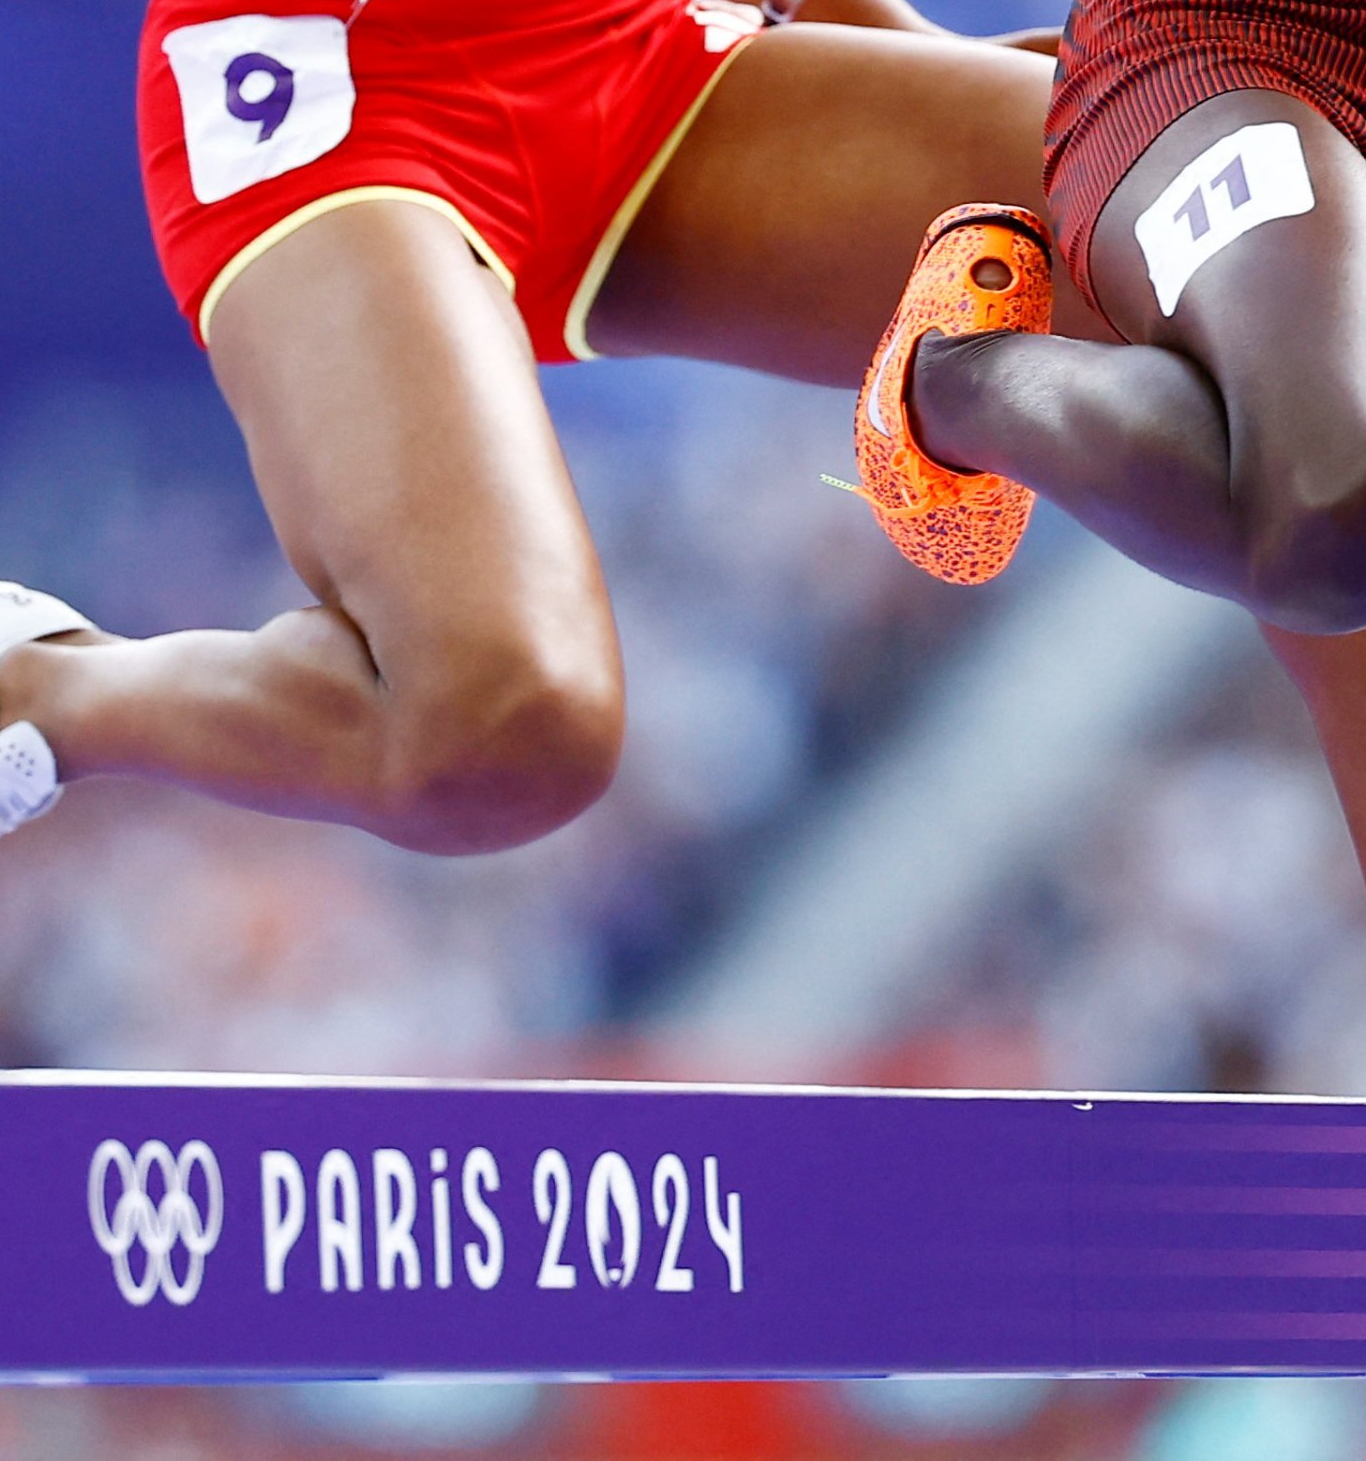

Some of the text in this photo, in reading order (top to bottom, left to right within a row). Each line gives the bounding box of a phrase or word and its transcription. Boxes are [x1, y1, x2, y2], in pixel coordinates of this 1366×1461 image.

[224, 52, 294, 144] 9
[1173, 153, 1252, 242] 11
[534, 1147, 744, 1293] 2024
